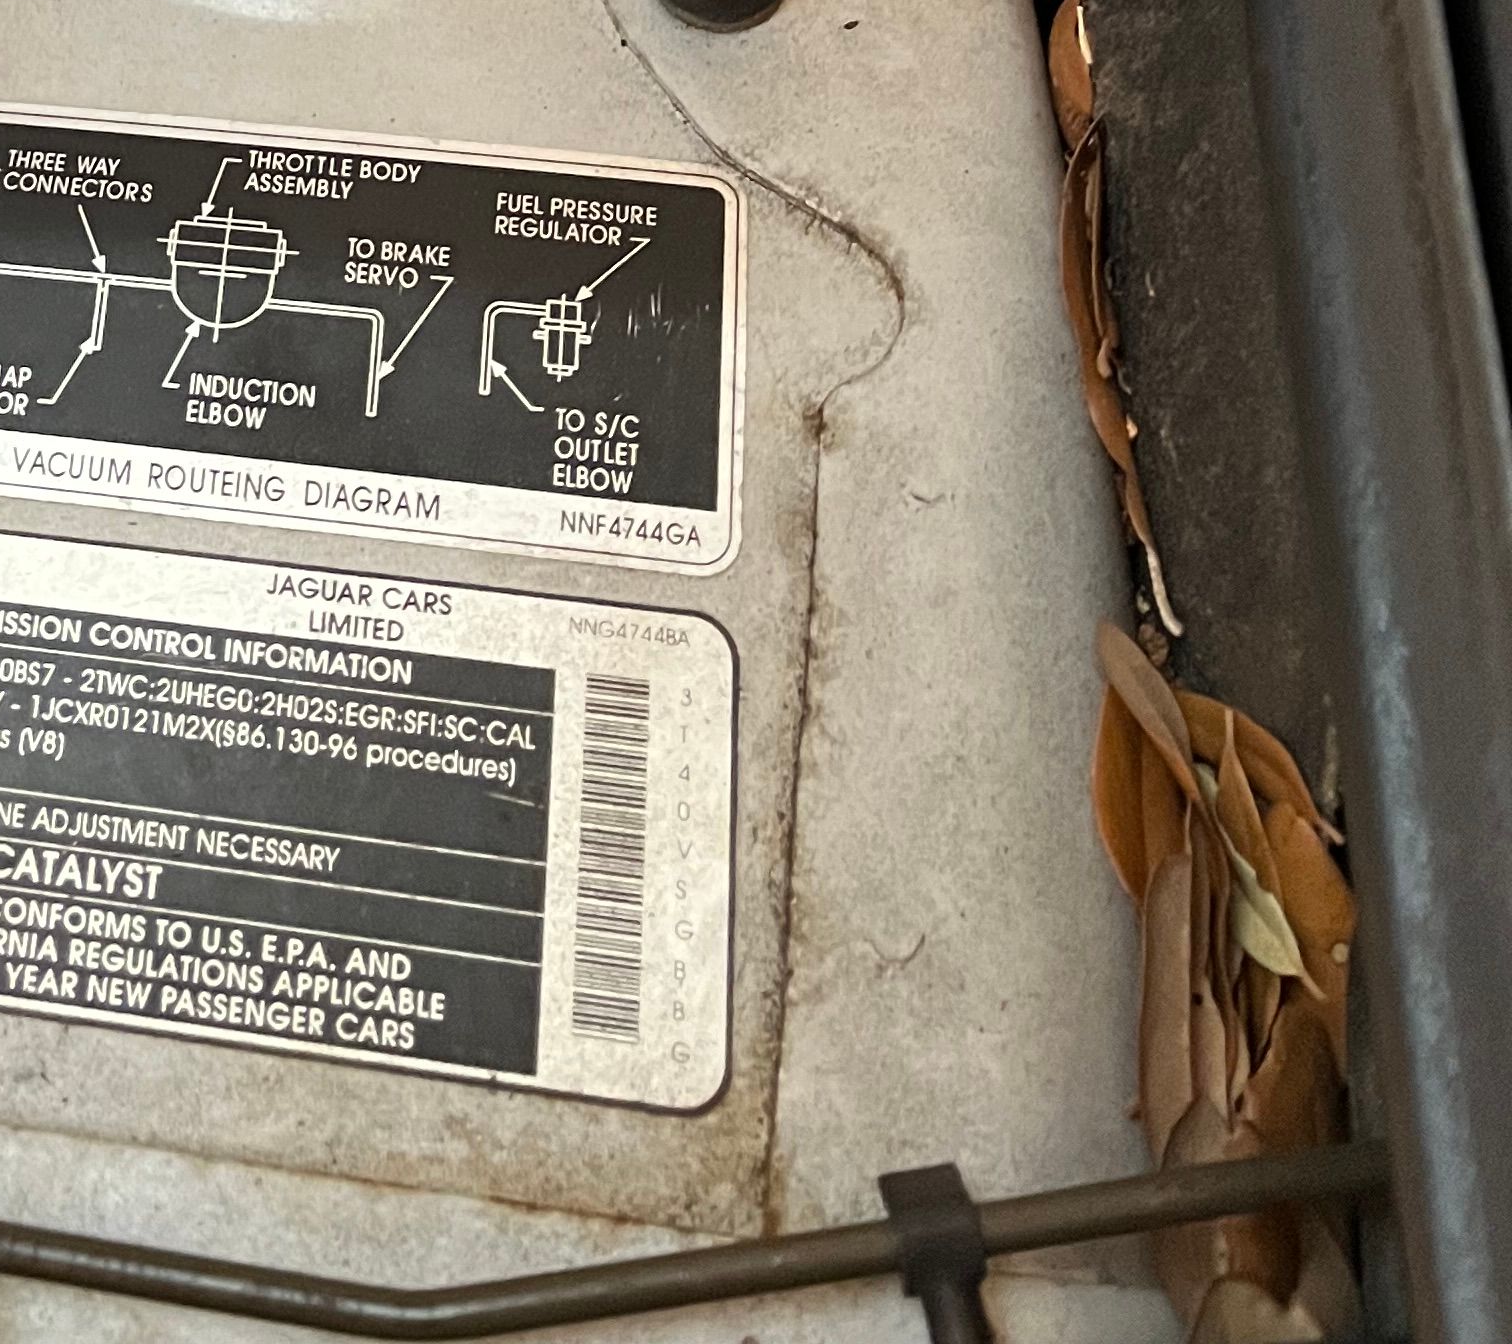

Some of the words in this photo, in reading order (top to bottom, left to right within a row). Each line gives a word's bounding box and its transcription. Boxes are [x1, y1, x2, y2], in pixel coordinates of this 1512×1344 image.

[8, 149, 66, 171] THREE
[77, 155, 120, 176] WAY
[249, 150, 352, 177] THROTTLE
[359, 160, 421, 183] BODY
[3, 171, 152, 202] CONNECTORS
[243, 172, 353, 199] ASSEMBLY
[496, 192, 543, 214] FUEL
[550, 197, 657, 226] PRESSURE
[495, 215, 621, 245] REGULATOR
[348, 237, 375, 258] TO
[381, 241, 450, 266] BRAKE
[344, 261, 418, 288] SERVO
[189, 372, 315, 407] INDUCTION
[185, 399, 266, 429] ELBOW
[555, 407, 585, 432] TO
[594, 411, 639, 438] S/C
[554, 436, 639, 466] OUTLET
[13, 447, 131, 484] VACUUM
[148, 462, 285, 501] ROUTEING
[304, 480, 440, 520] DIAGRAM
[552, 463, 633, 493] ELBOW
[560, 510, 701, 547] NNF4744GA
[266, 573, 372, 606] JAGUAR
[382, 587, 451, 615] CARS
[309, 610, 404, 641] LIMITED
[89, 621, 215, 660] CONTROL
[224, 638, 412, 684] INFORMATION
[18, 727, 64, 760] (V8)
[366, 744, 515, 786] procedures)
[31, 806, 190, 850] ADJUSTMENT
[196, 828, 340, 871] NECESSARY
[156, 918, 191, 949] TO
[201, 926, 250, 958] U.S.
[261, 934, 336, 971] E.P.A.
[344, 948, 411, 980] AND
[68, 938, 263, 993] REGULATIONS
[272, 970, 445, 1020] APPLICABLE
[6, 962, 78, 998] YEAR
[86, 974, 152, 1009] NEW
[161, 985, 325, 1035] PASSENGER
[335, 1012, 414, 1049] CARS
